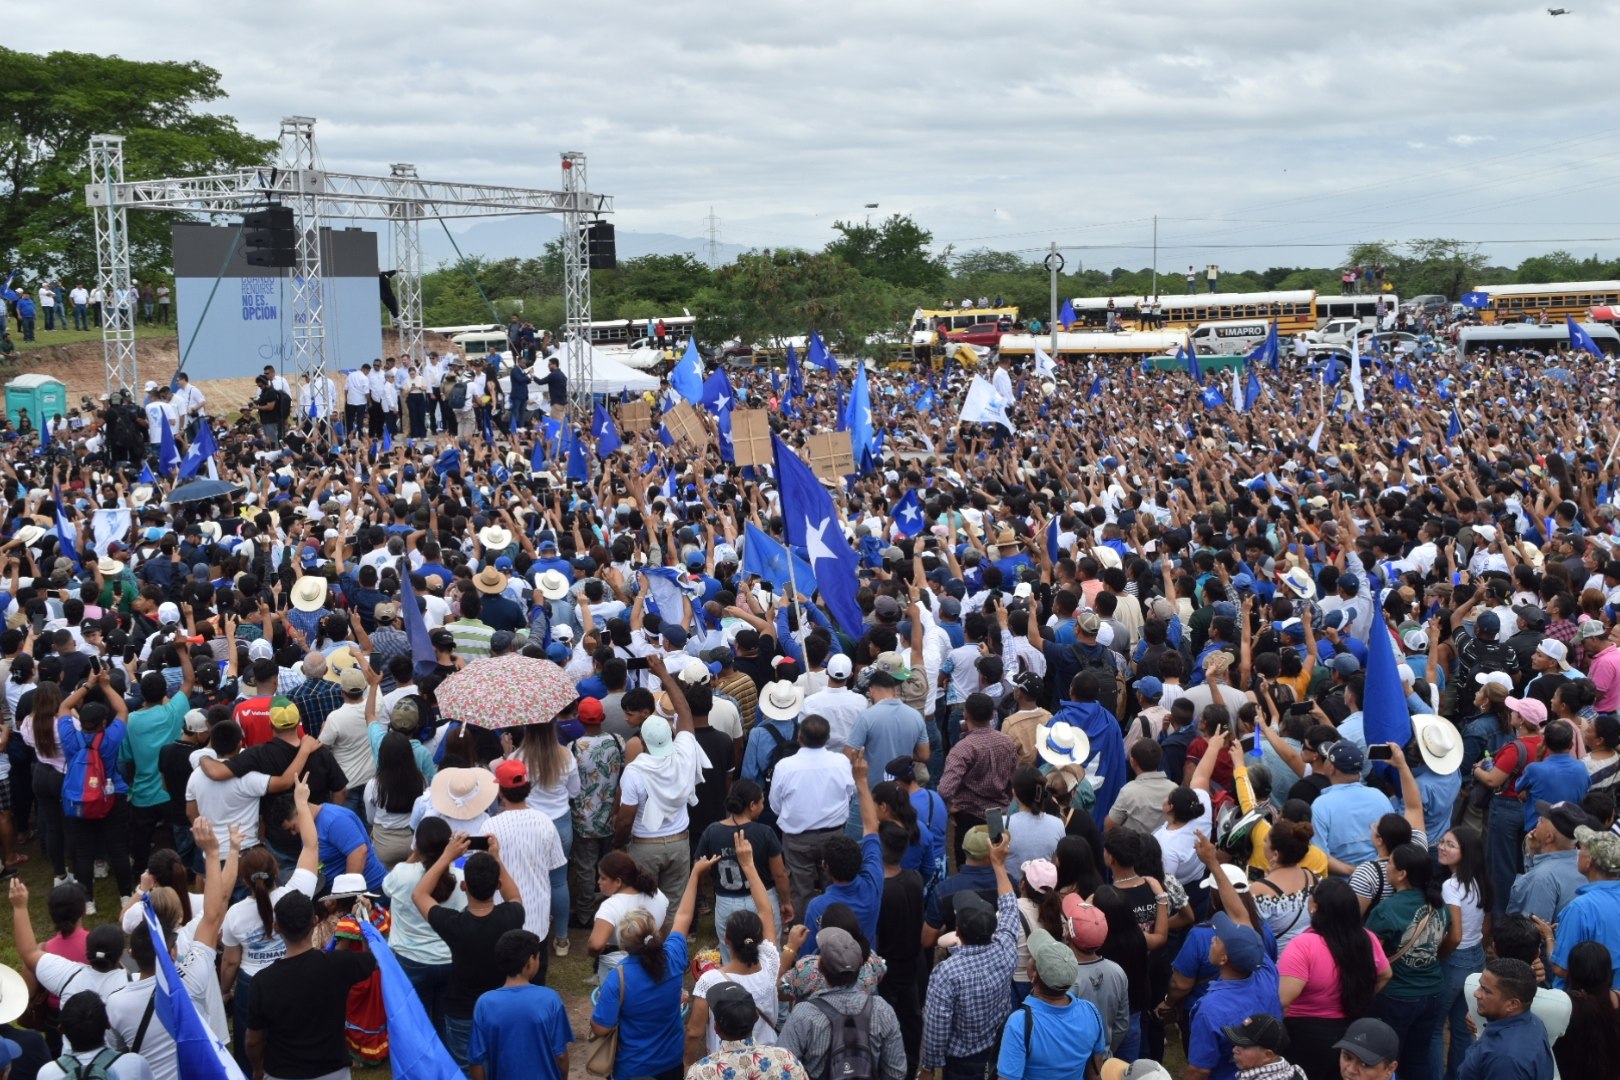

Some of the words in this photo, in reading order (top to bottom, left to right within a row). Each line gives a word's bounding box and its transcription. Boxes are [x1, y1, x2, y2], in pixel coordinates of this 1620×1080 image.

[242, 284, 275, 295] RENDIRSE
[242, 295, 254, 306] NO
[1225, 327, 1262, 336] IMAPRO
[247, 950, 287, 960] HERNAN
